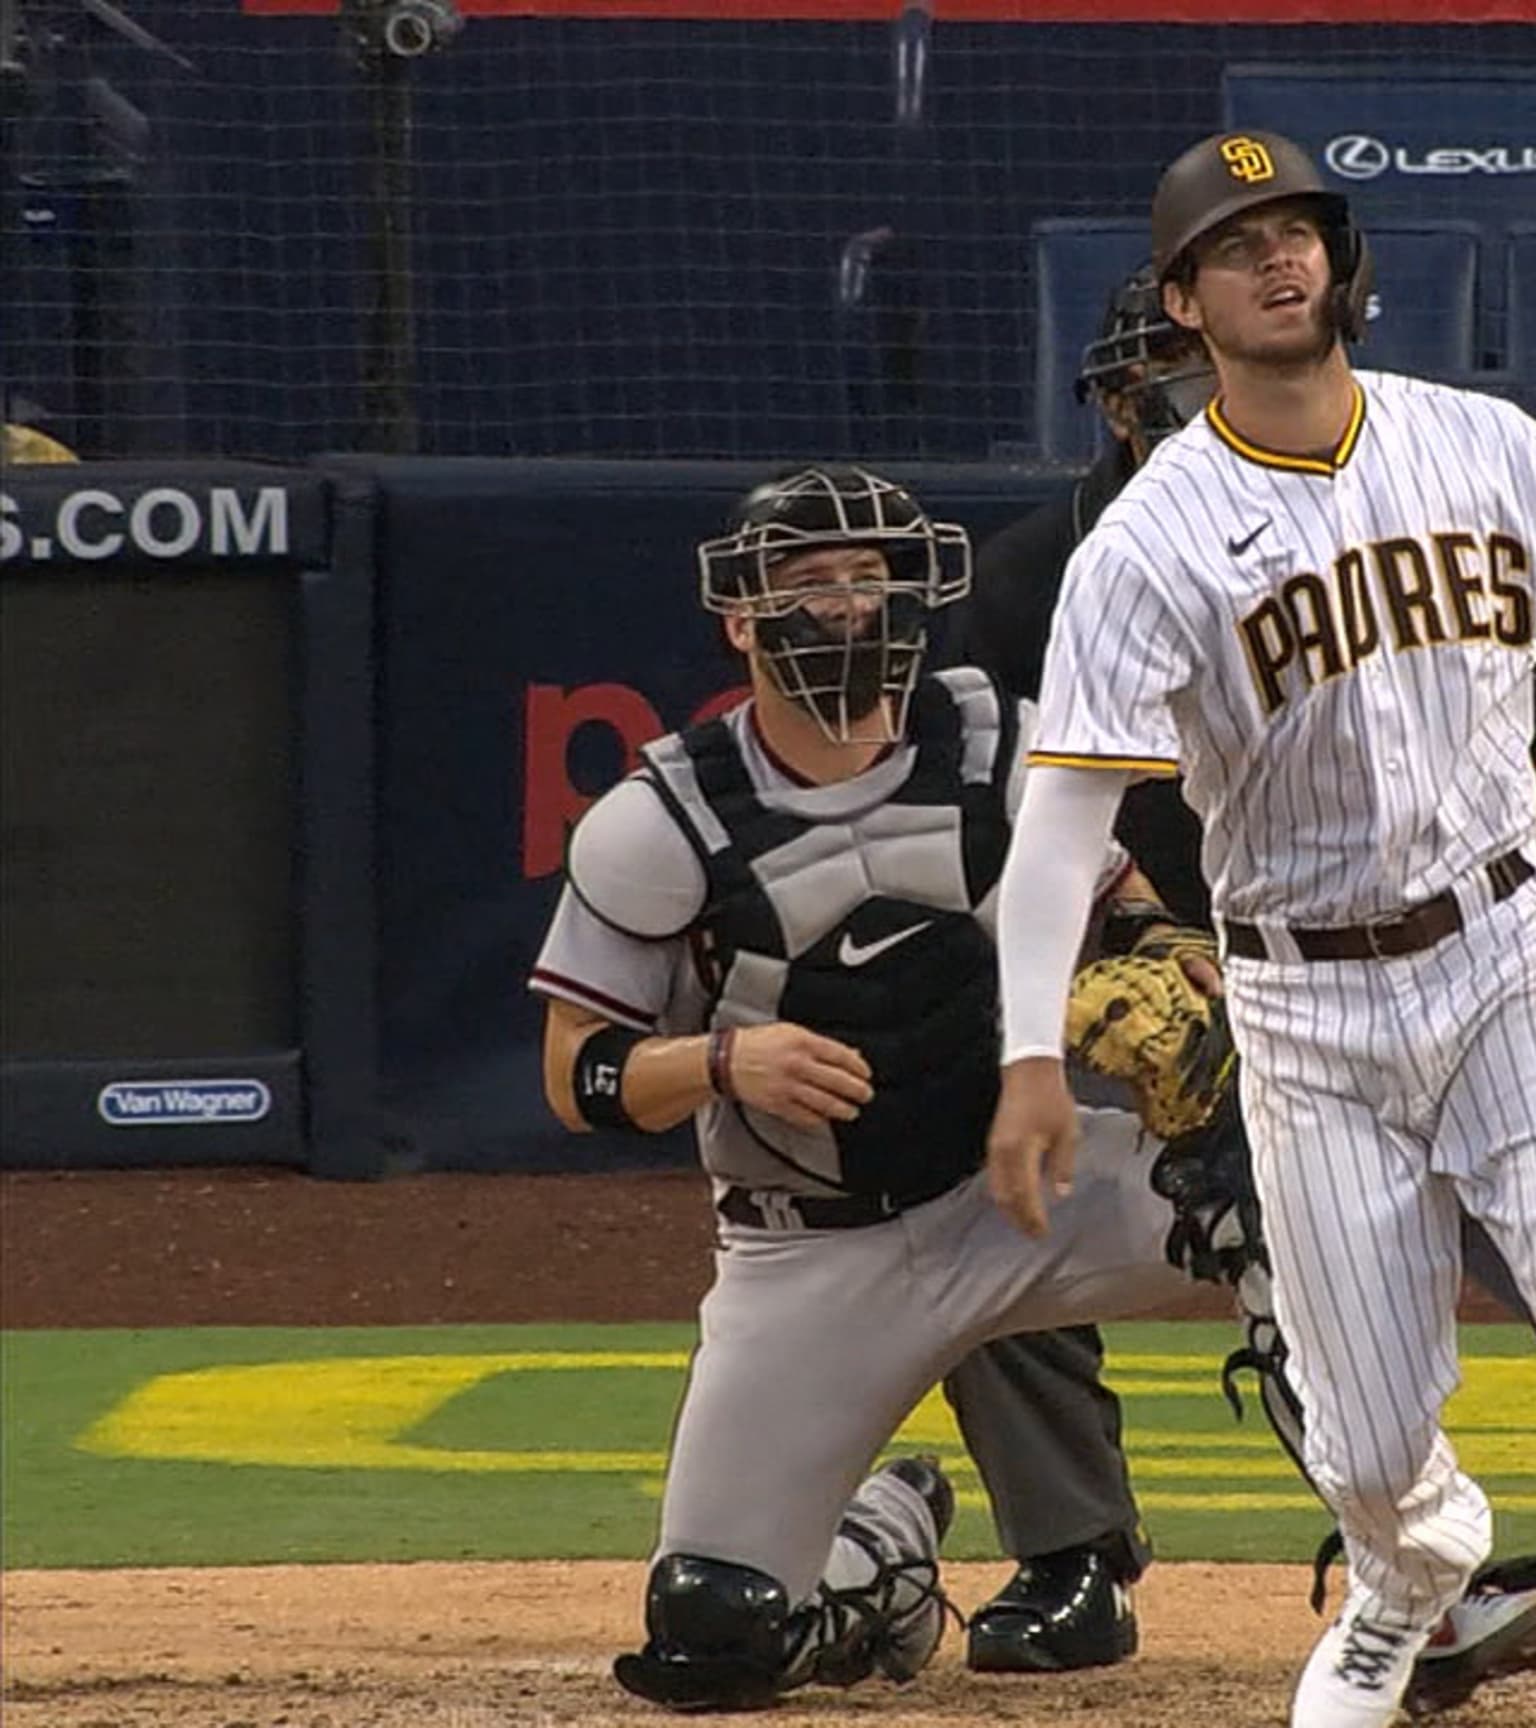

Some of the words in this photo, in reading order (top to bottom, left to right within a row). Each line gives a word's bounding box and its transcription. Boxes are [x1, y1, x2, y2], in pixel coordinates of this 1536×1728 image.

[1235, 531, 1535, 717] PADRES
[106, 1090, 162, 1113] Van
[163, 1089, 257, 1117] Wagner
